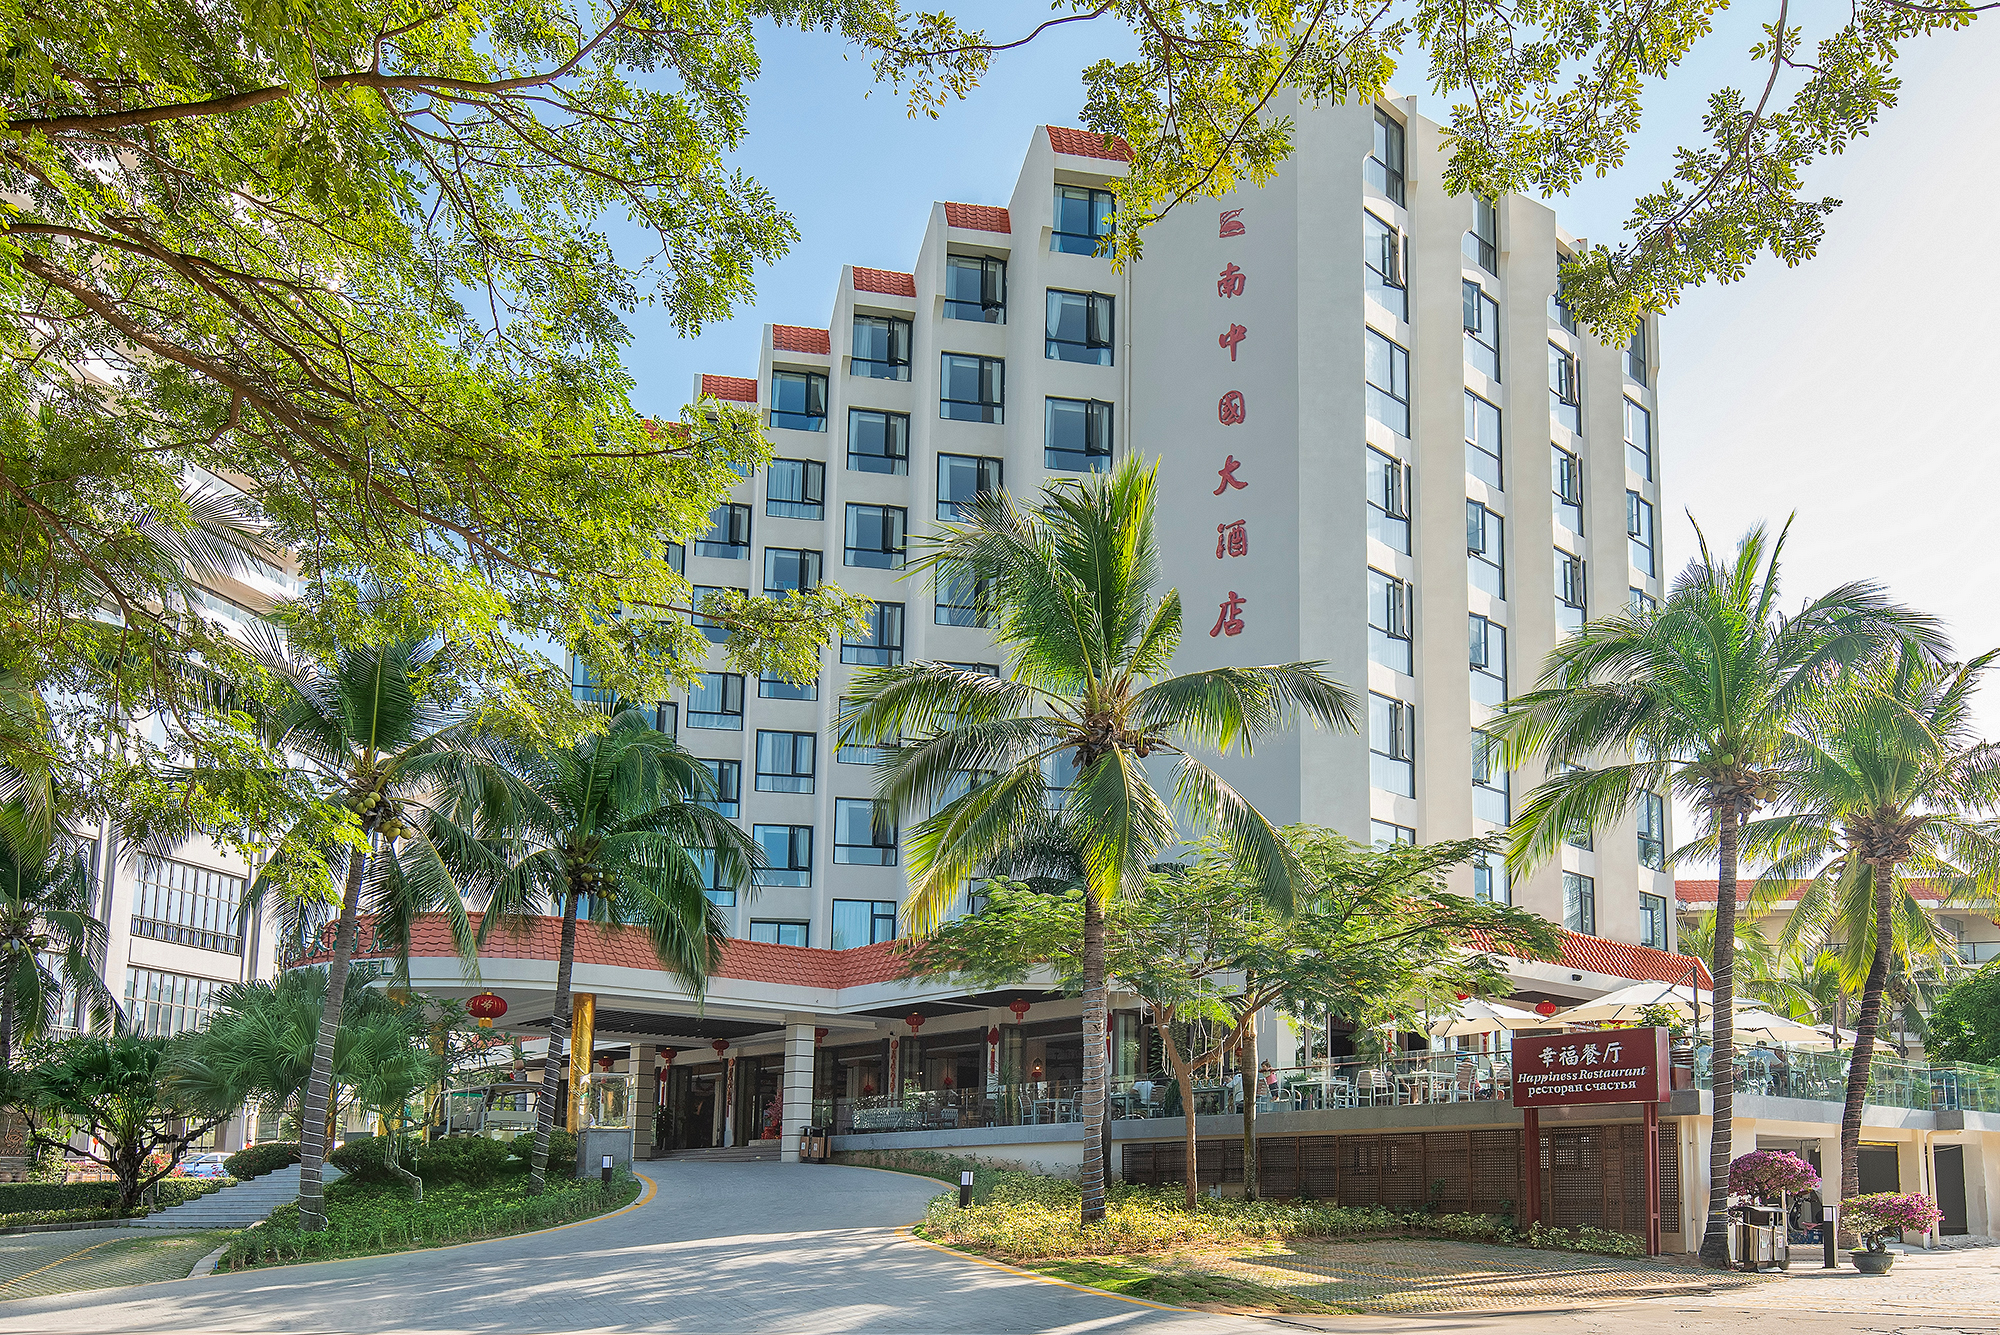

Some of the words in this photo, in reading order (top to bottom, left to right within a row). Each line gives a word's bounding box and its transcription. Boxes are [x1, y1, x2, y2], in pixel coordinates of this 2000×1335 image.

[1538, 1042, 1623, 1068] 幸福餐厅
[1517, 1072, 1578, 1085] Happiness
[1528, 1083, 1583, 1098] ресторан
[1585, 1080, 1637, 1092] счастья
